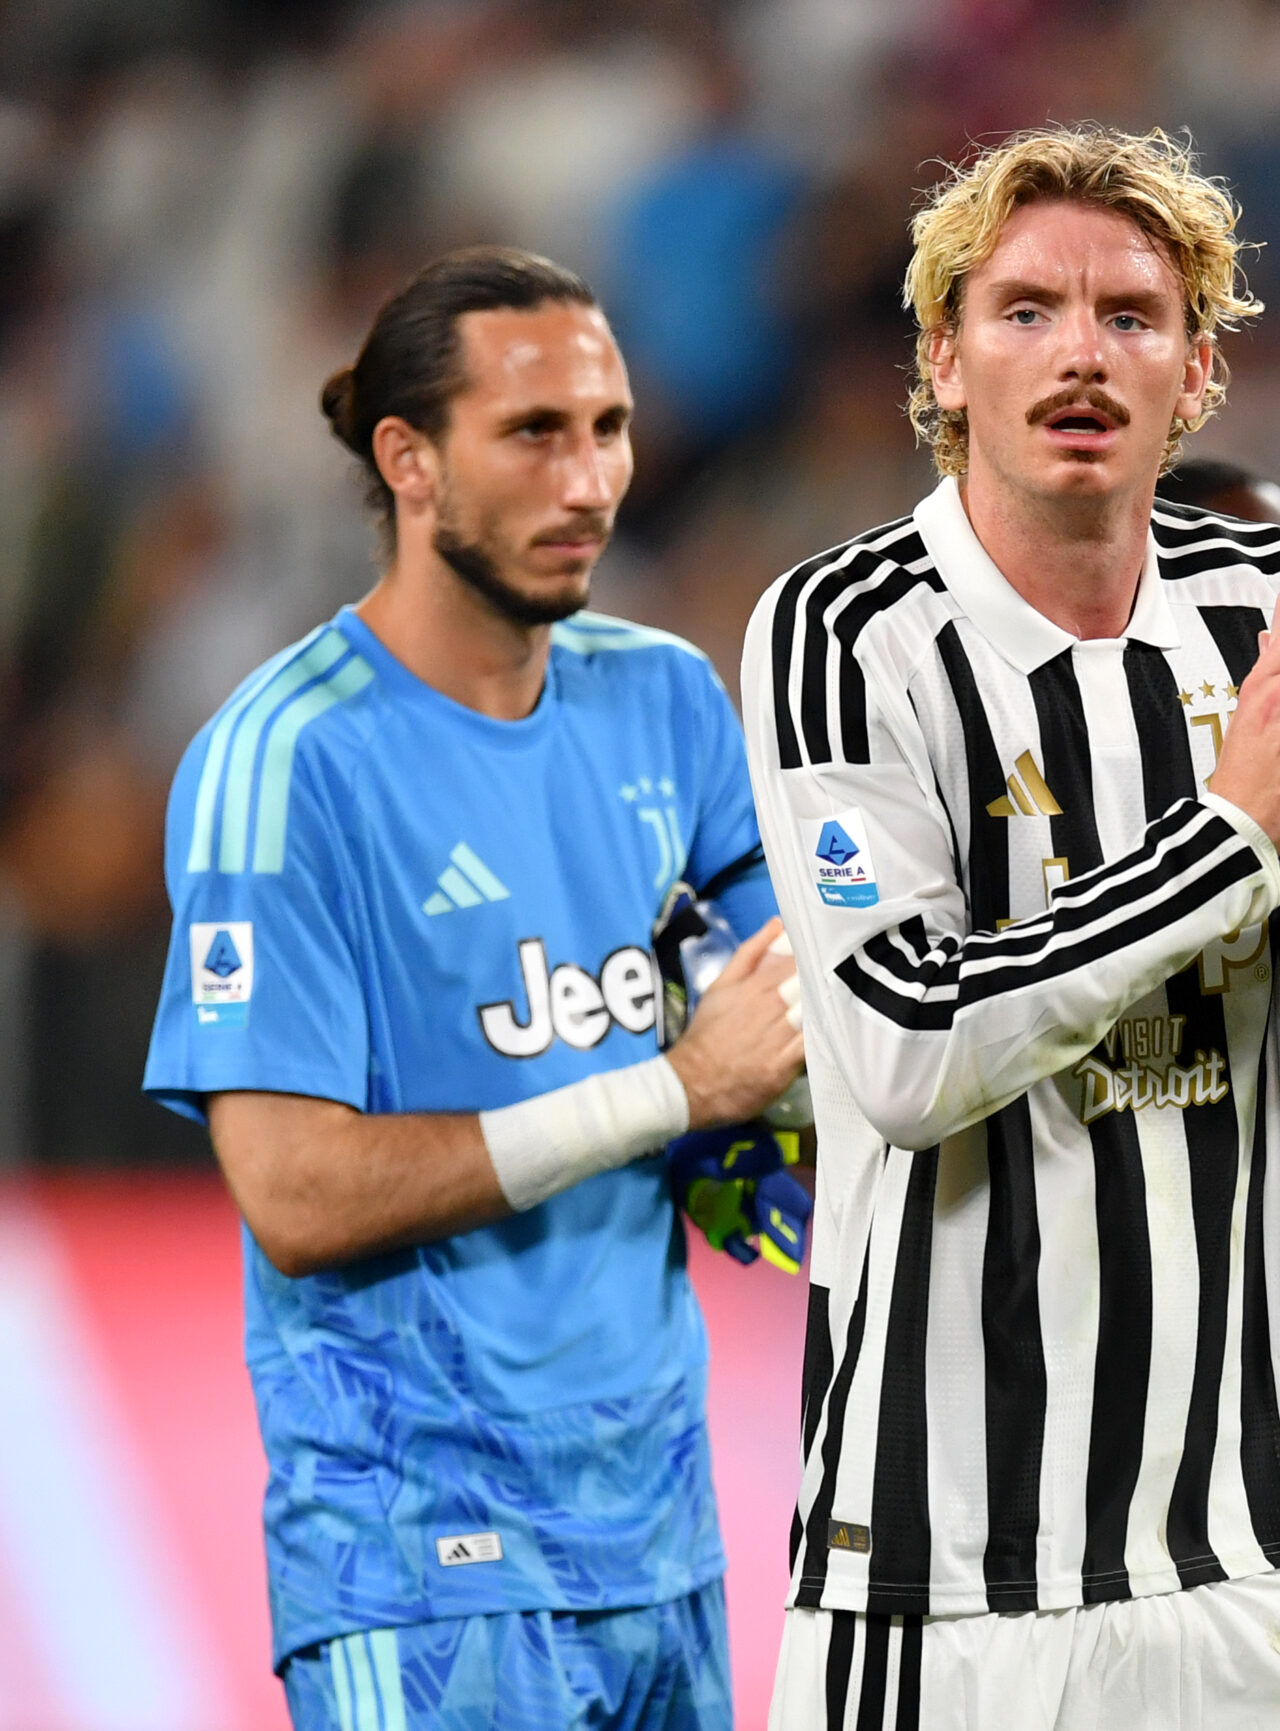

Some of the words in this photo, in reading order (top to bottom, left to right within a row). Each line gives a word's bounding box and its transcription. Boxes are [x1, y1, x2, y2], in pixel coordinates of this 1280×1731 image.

[819, 867, 853, 878] SERIE
[857, 866, 866, 876] A
[477, 936, 664, 1059] Jee
[1103, 1015, 1187, 1061] VISIT
[1073, 1048, 1229, 1126] Detroit
